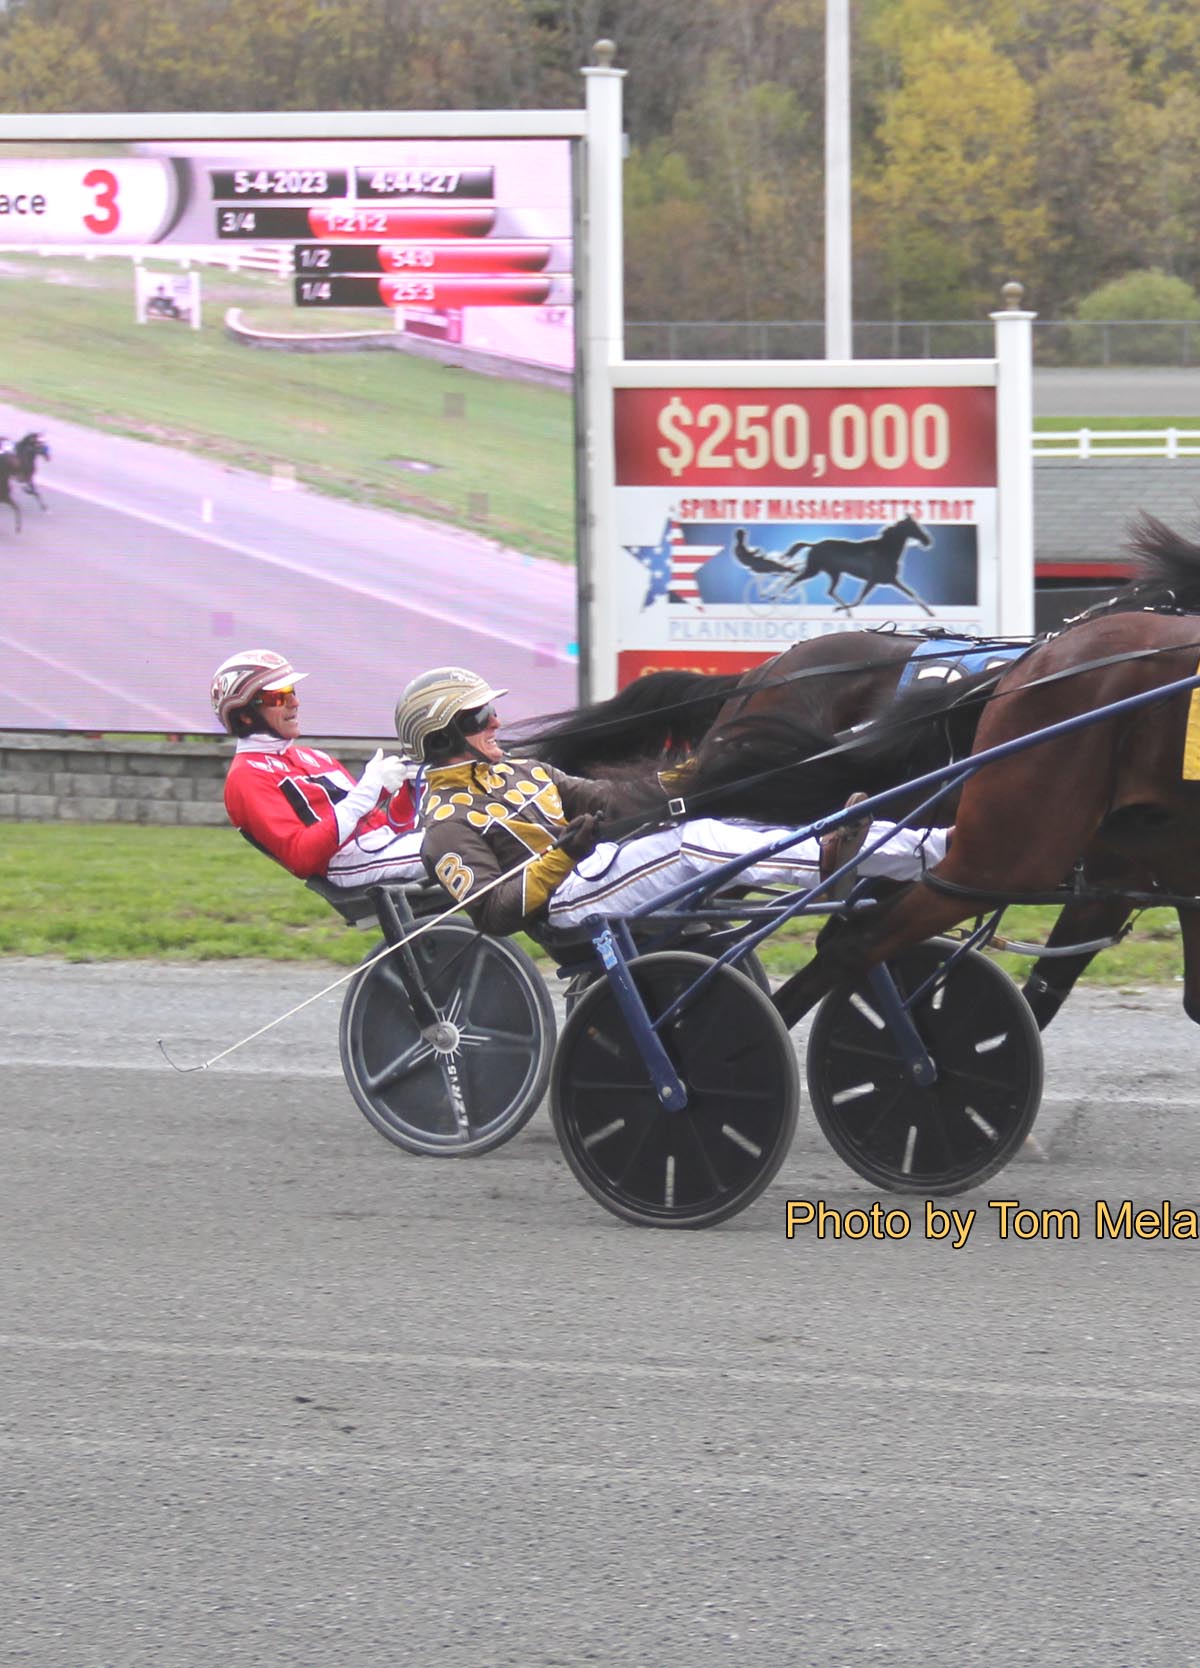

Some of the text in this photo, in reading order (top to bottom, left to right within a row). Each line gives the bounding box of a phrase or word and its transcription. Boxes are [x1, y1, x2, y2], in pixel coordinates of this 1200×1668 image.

[234, 171, 328, 194] 5-4-2023
[369, 171, 461, 193] 4:44:27
[82, 168, 121, 235] 3
[221, 212, 256, 232] 3/4
[324, 212, 388, 232] 1:21:2
[300, 250, 331, 268] 1/2
[301, 283, 332, 300] 1/4
[657, 396, 950, 477] $250,000
[680, 499, 975, 520] SPIRIT OF MASSACHUSETTS TROT
